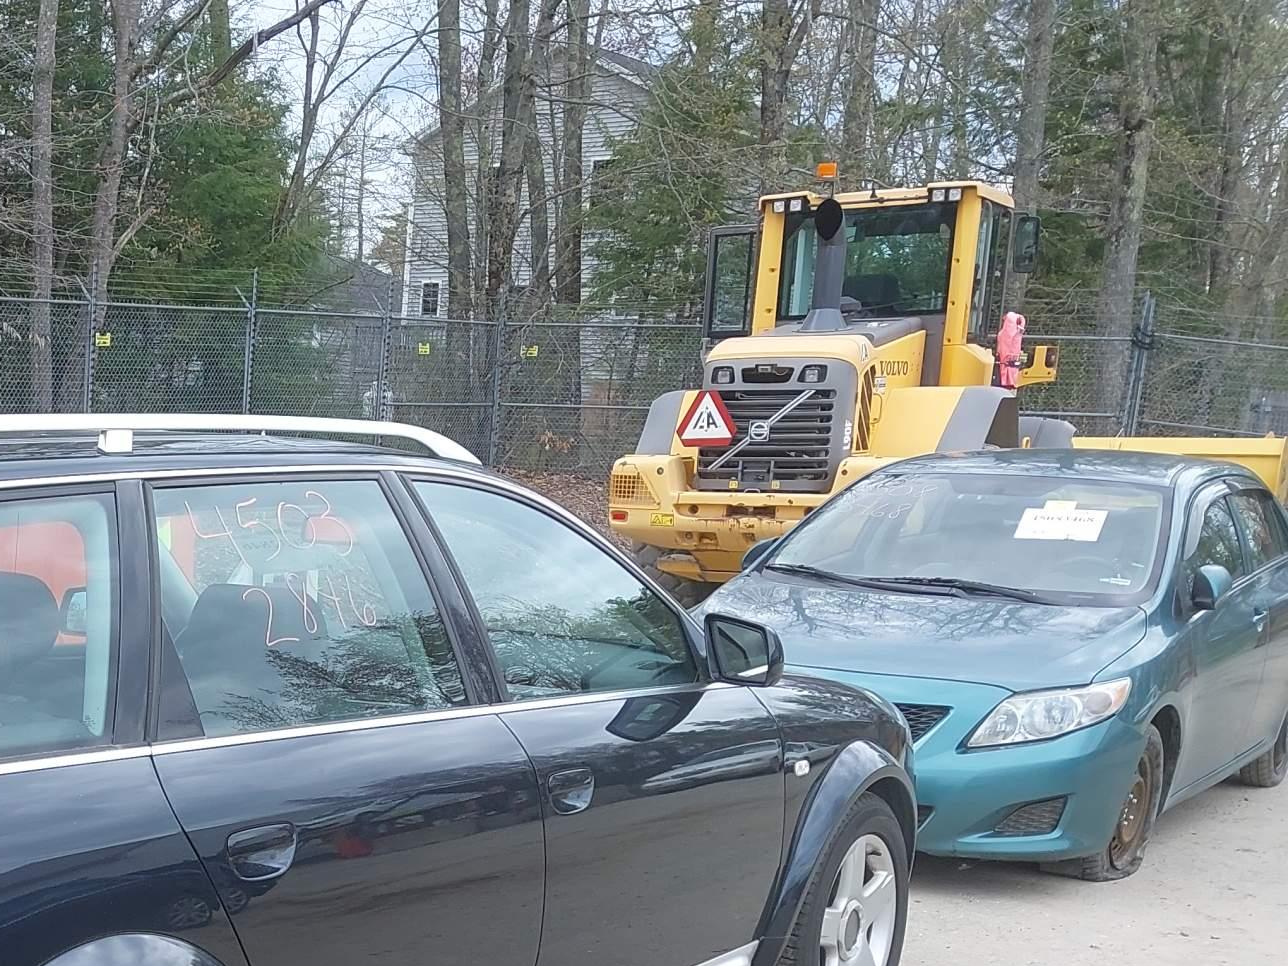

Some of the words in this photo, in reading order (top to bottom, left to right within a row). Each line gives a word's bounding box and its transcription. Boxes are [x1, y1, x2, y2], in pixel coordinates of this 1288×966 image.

[879, 360, 909, 376] VOLVO
[843, 419, 853, 450] L90F
[184, 490, 353, 567] 4503
[241, 572, 377, 648] 2846
